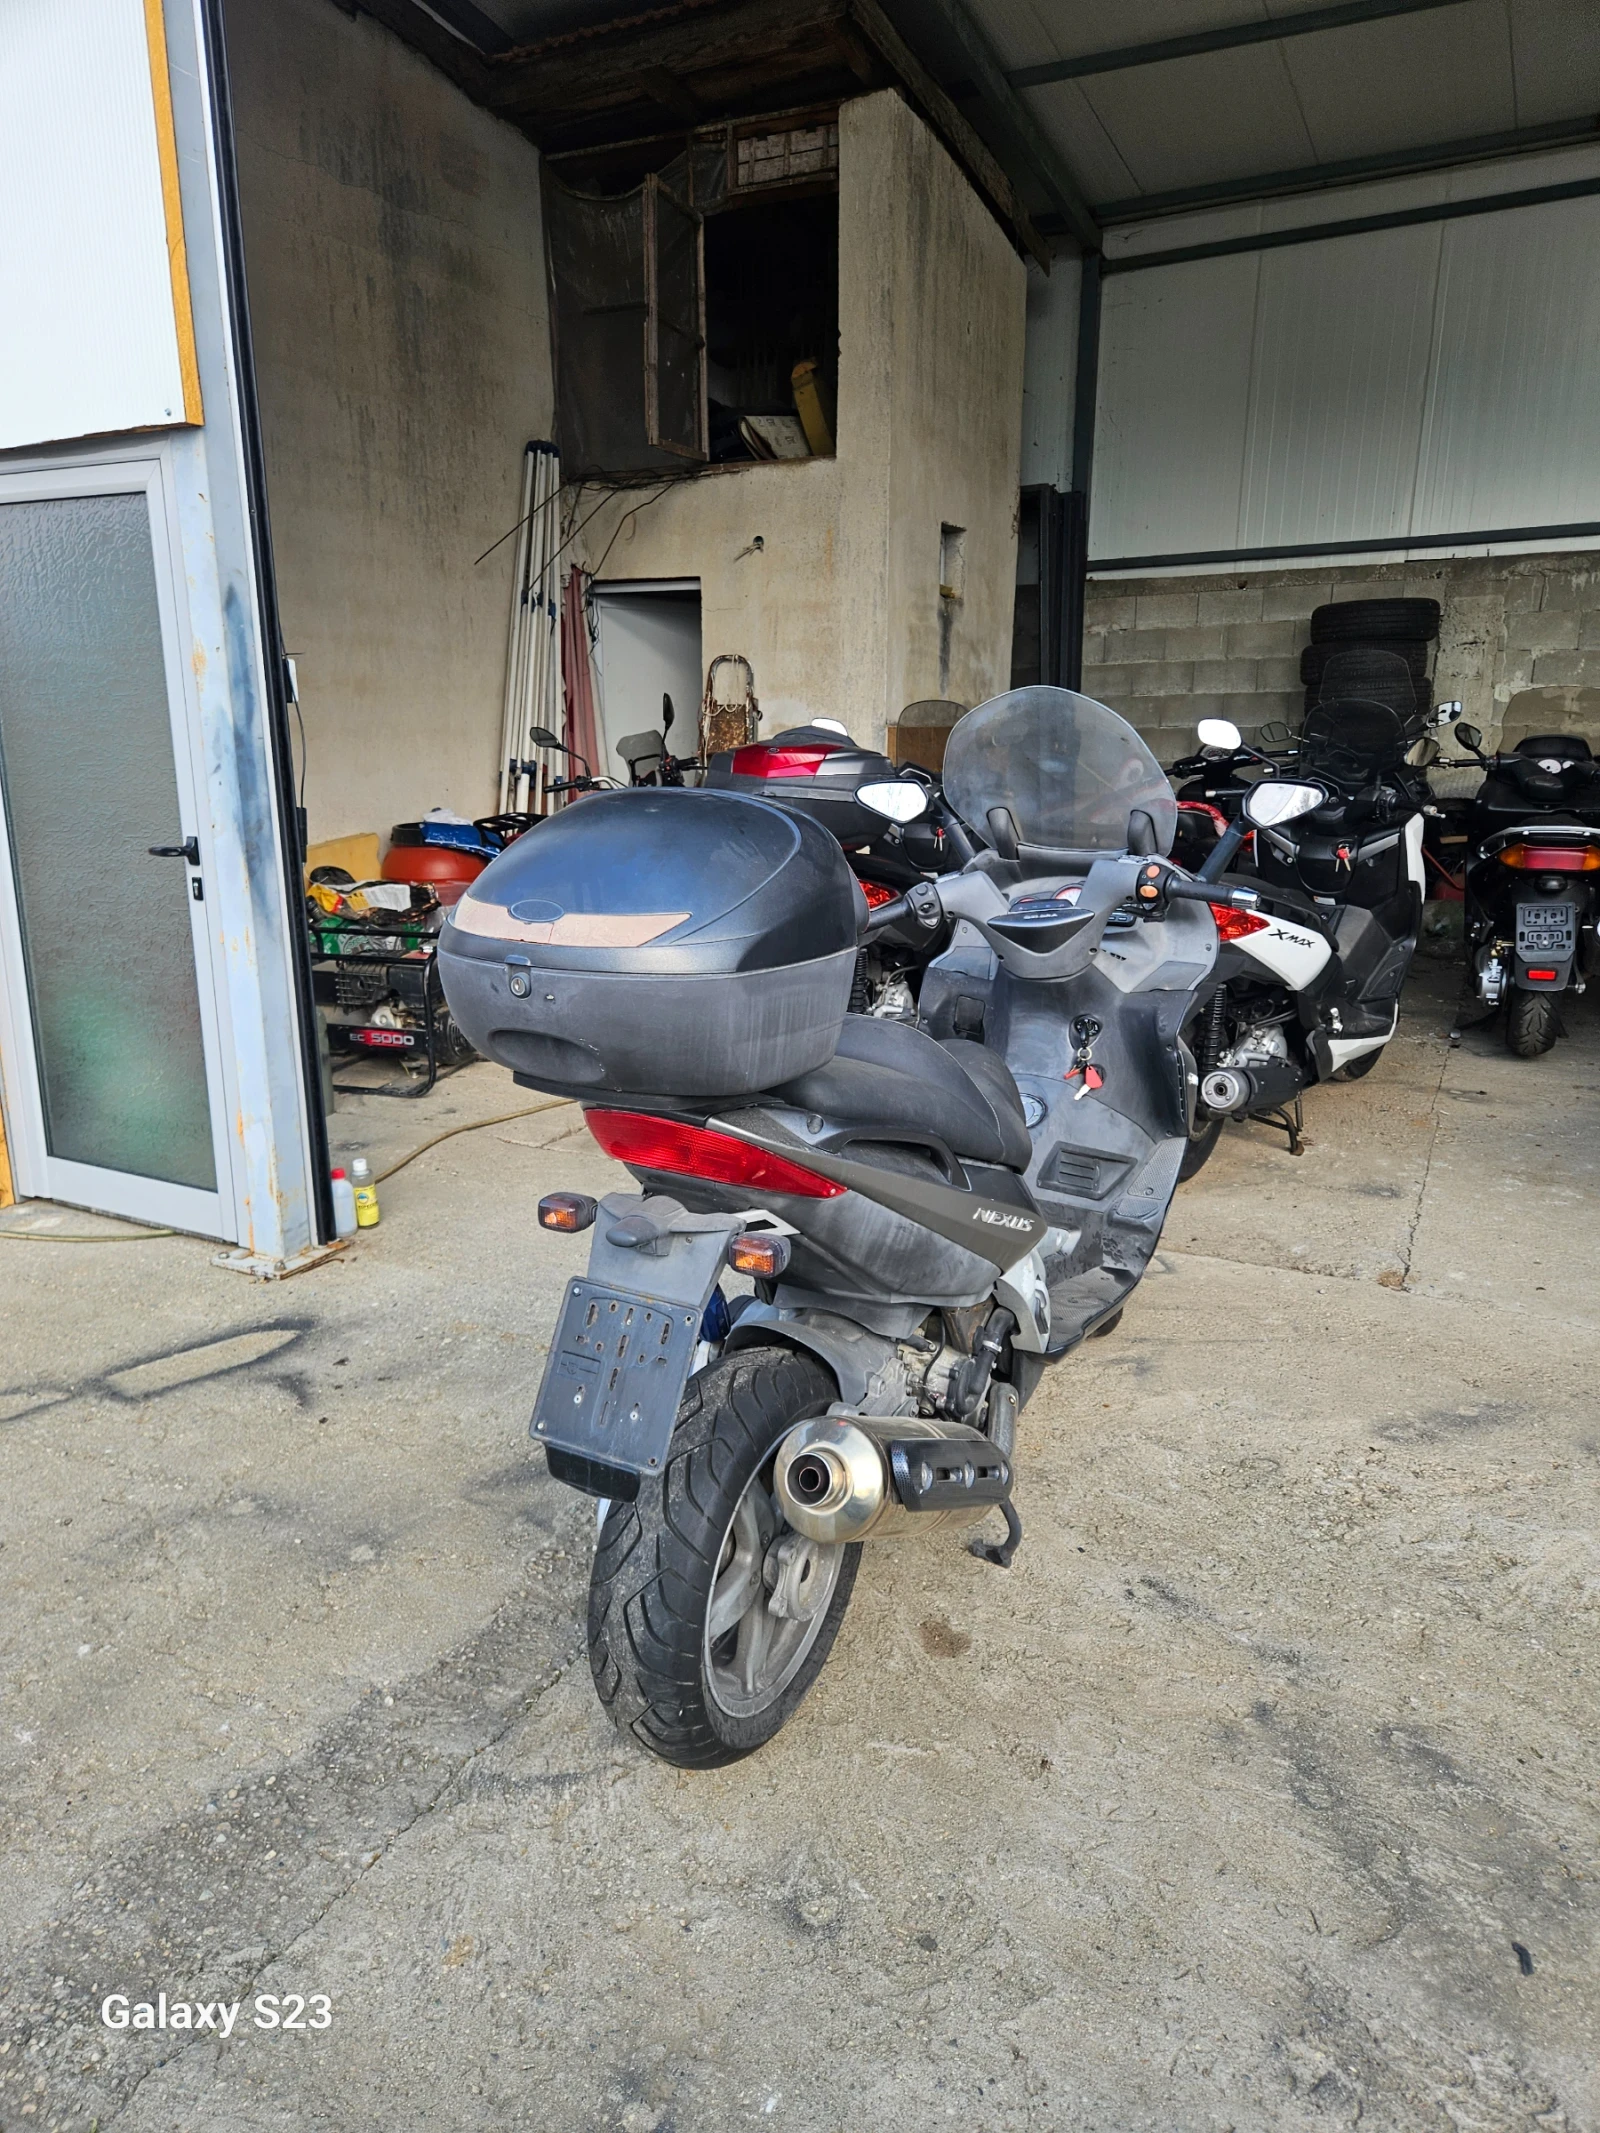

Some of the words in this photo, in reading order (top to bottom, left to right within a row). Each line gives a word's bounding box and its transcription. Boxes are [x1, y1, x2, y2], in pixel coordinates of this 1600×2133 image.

[350, 1033, 365, 1042] EC
[371, 1033, 415, 1046] 5000
[973, 1207, 1035, 1232] NEXUS
